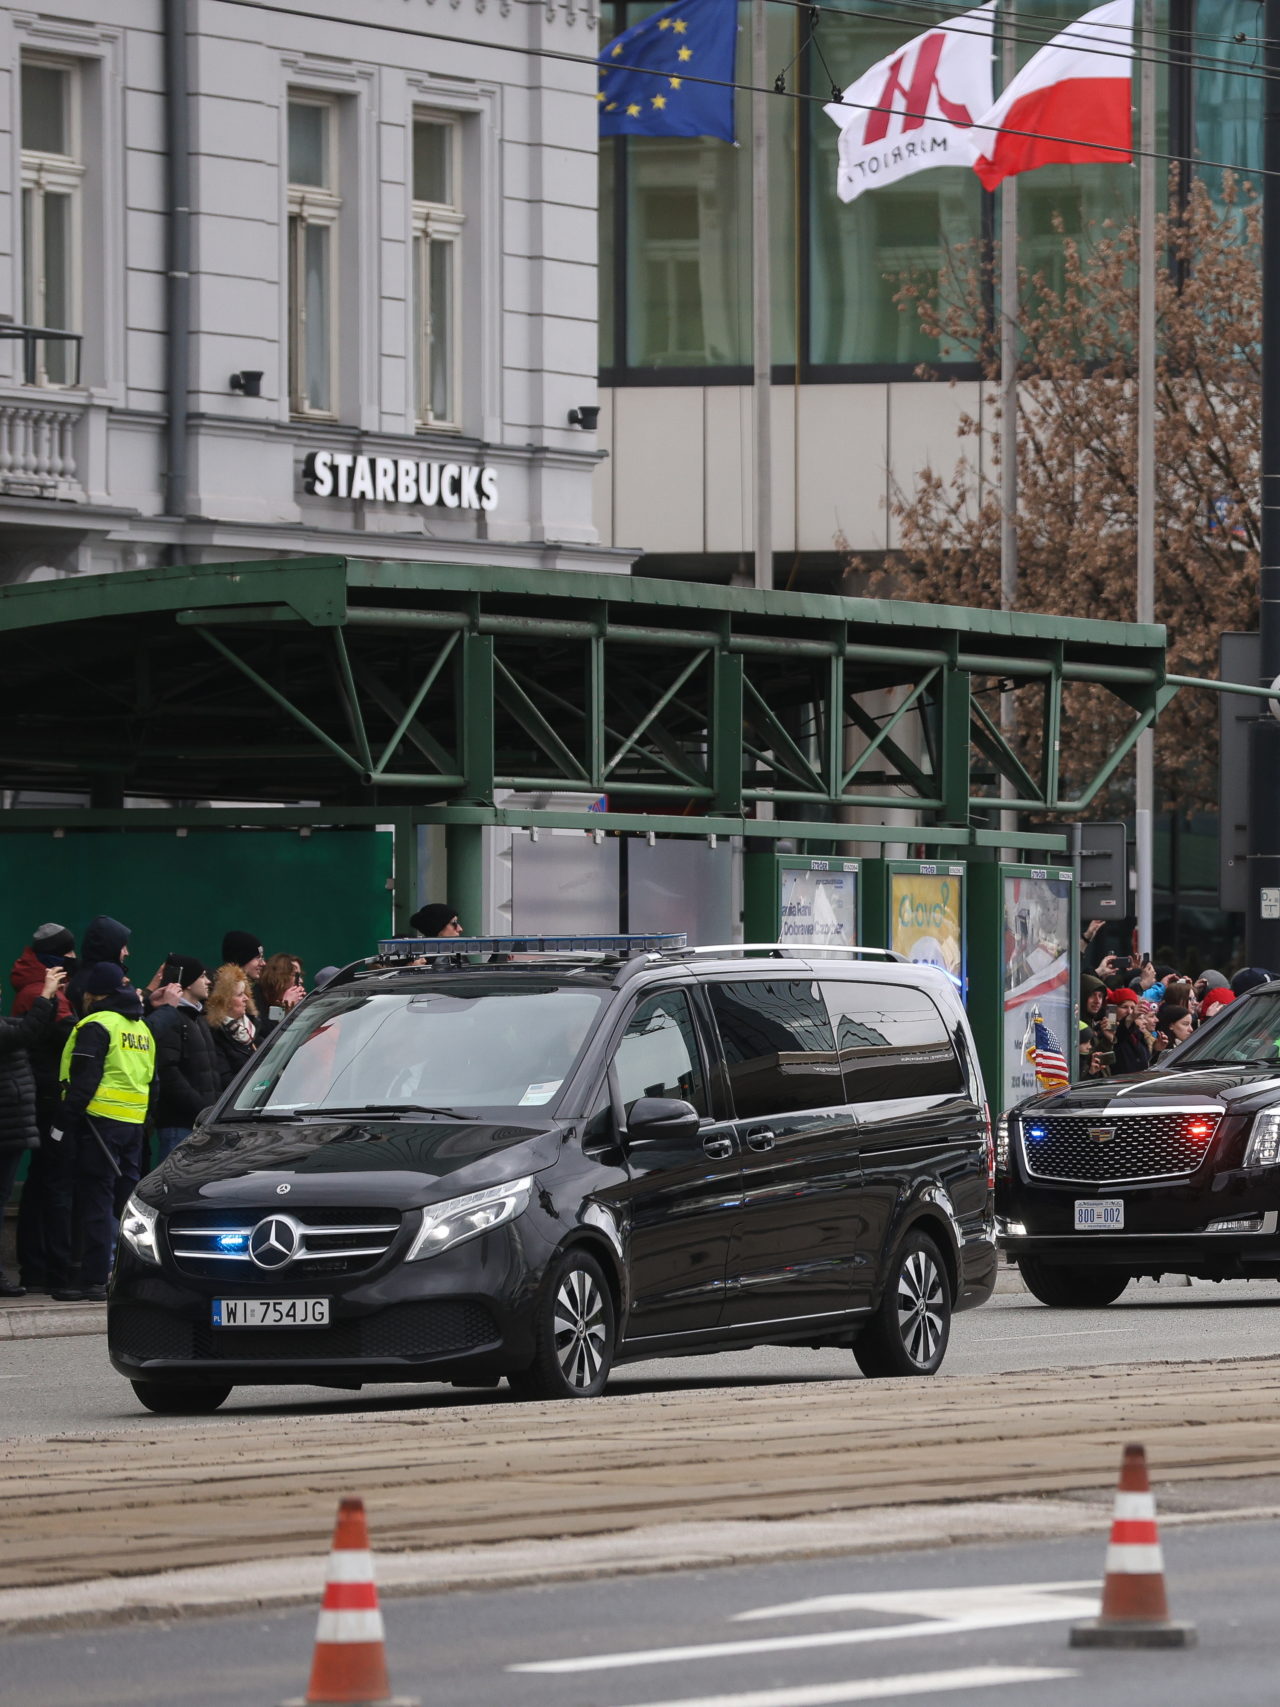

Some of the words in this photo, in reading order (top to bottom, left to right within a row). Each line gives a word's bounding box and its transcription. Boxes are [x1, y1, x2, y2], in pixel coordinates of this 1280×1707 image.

[314, 450, 499, 511] STARBUCKS
[1078, 1208, 1095, 1223] 800
[1103, 1207, 1121, 1223] 002
[226, 1302, 247, 1323] WI
[259, 1300, 325, 1323] 754JG
